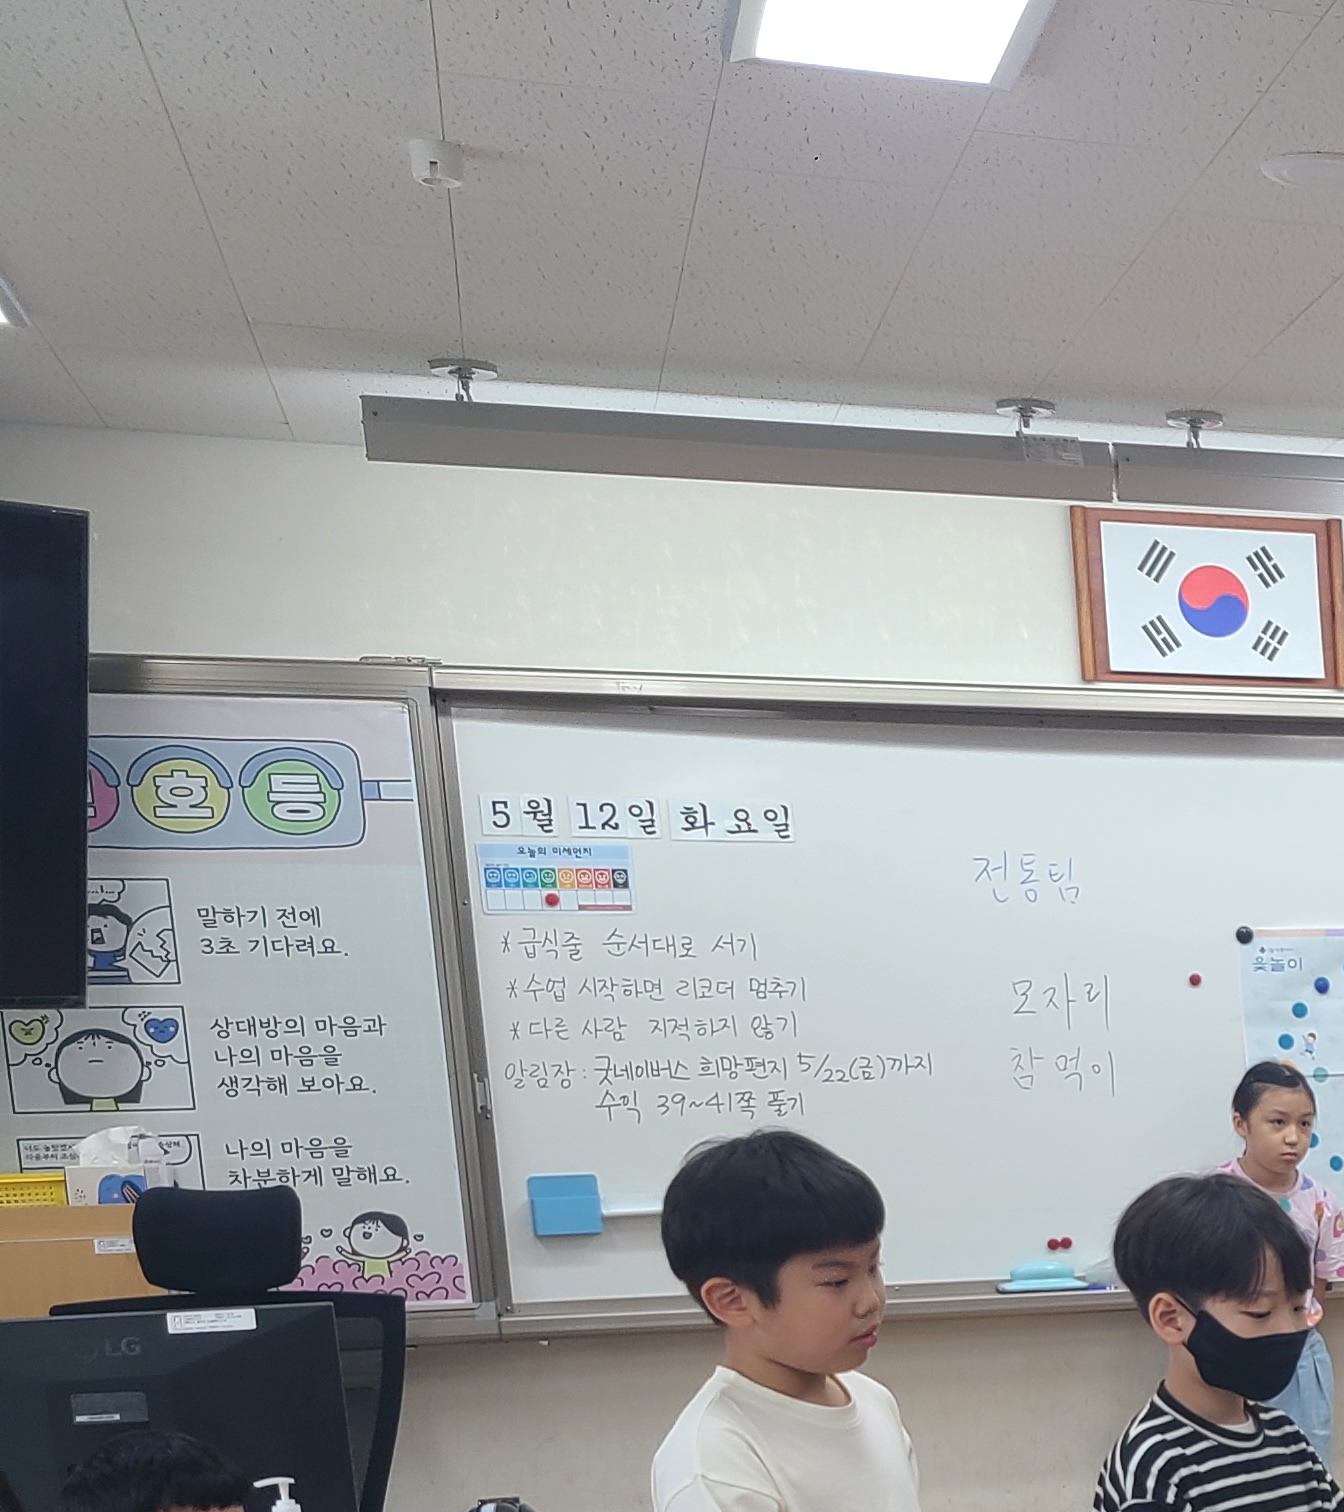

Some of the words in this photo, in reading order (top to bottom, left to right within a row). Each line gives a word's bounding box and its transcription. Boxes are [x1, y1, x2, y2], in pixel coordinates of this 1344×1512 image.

[88, 768, 326, 822] 호등
[492, 797, 553, 833] 5월
[576, 800, 656, 835] 12일
[517, 846, 546, 858] 오늘의
[552, 846, 592, 859] 미세먼지
[973, 850, 1082, 904] 전통팀
[197, 906, 266, 928] 말하기
[276, 906, 320, 928] 전에
[200, 937, 240, 954] 3초
[248, 935, 348, 957] 기다려요.
[517, 928, 583, 961] 급식줄
[602, 927, 697, 959] 순서대로
[711, 932, 756, 961] 서기
[522, 972, 566, 1002] 수업
[578, 976, 665, 1002] 시작하면
[676, 976, 734, 1000] 리코더
[749, 977, 805, 1001] 멈추기
[1012, 973, 1108, 1030] 모자리
[210, 1015, 305, 1039] 상대방의
[314, 1014, 387, 1037] 마음과
[529, 1017, 569, 1040] 다른
[582, 1016, 627, 1042] 사람
[648, 1015, 737, 1042] 지적하지
[751, 1010, 796, 1040] 않기
[214, 1045, 264, 1068] 나의
[270, 1045, 342, 1067] 마음을
[594, 1056, 691, 1086] 굿네이버스
[697, 1055, 787, 1081] 희망편지
[217, 1074, 287, 1097] 생각해
[297, 1073, 376, 1094] 보아요.
[595, 1090, 641, 1124] 수익
[657, 1091, 757, 1120] 39~41쪽
[767, 1090, 803, 1117] 풀기
[225, 1138, 274, 1161] 나의
[281, 1137, 352, 1159] 마음을
[228, 1165, 323, 1188] 차분하게
[332, 1164, 409, 1187] 말해요.
[105, 1337, 141, 1356] LG
